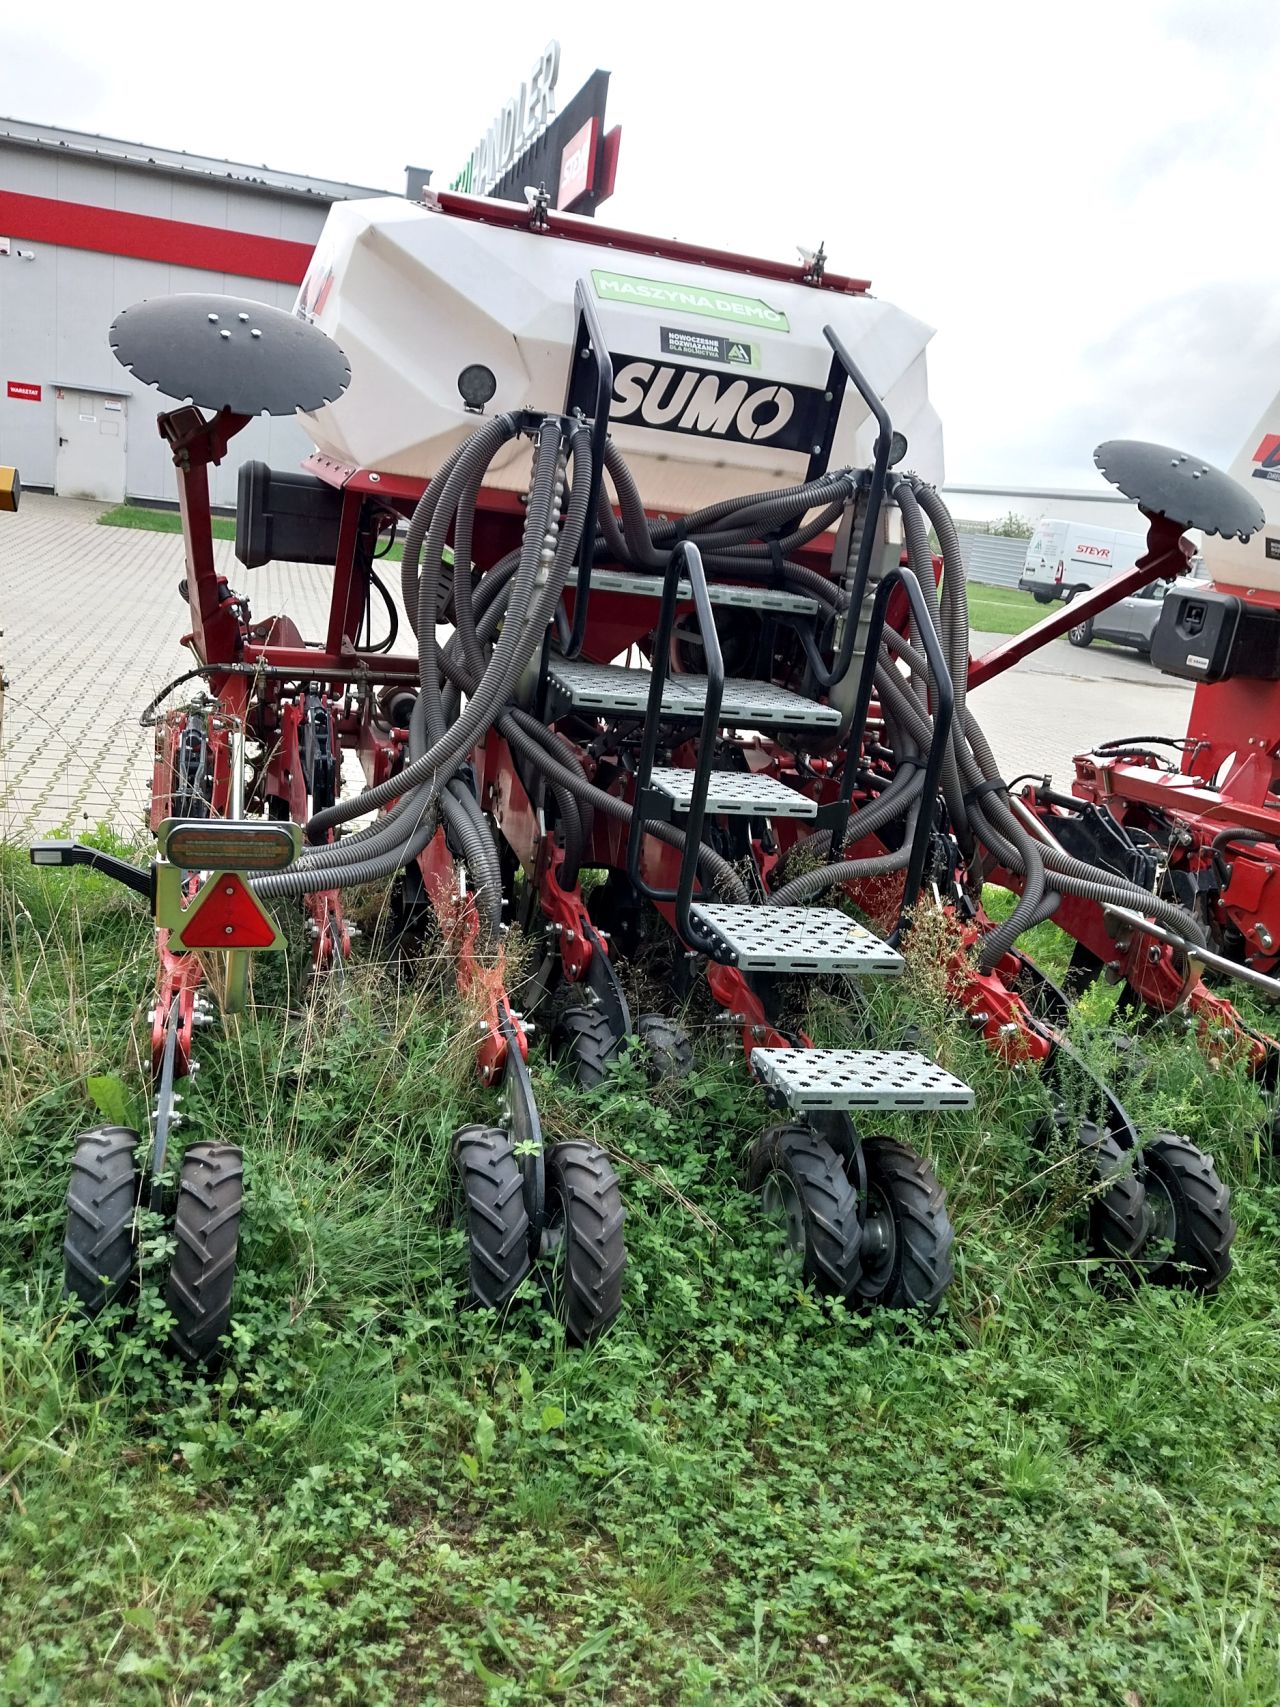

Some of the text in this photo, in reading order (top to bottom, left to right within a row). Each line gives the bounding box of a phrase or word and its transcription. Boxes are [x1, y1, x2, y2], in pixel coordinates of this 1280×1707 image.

[600, 279, 781, 321] MASZYNA DEMO
[668, 332, 719, 347] NOWOCZESNE
[10, 387, 38, 395] WARSZTAT
[608, 361, 795, 440] SUMO
[1076, 544, 1111, 558] STEYR
